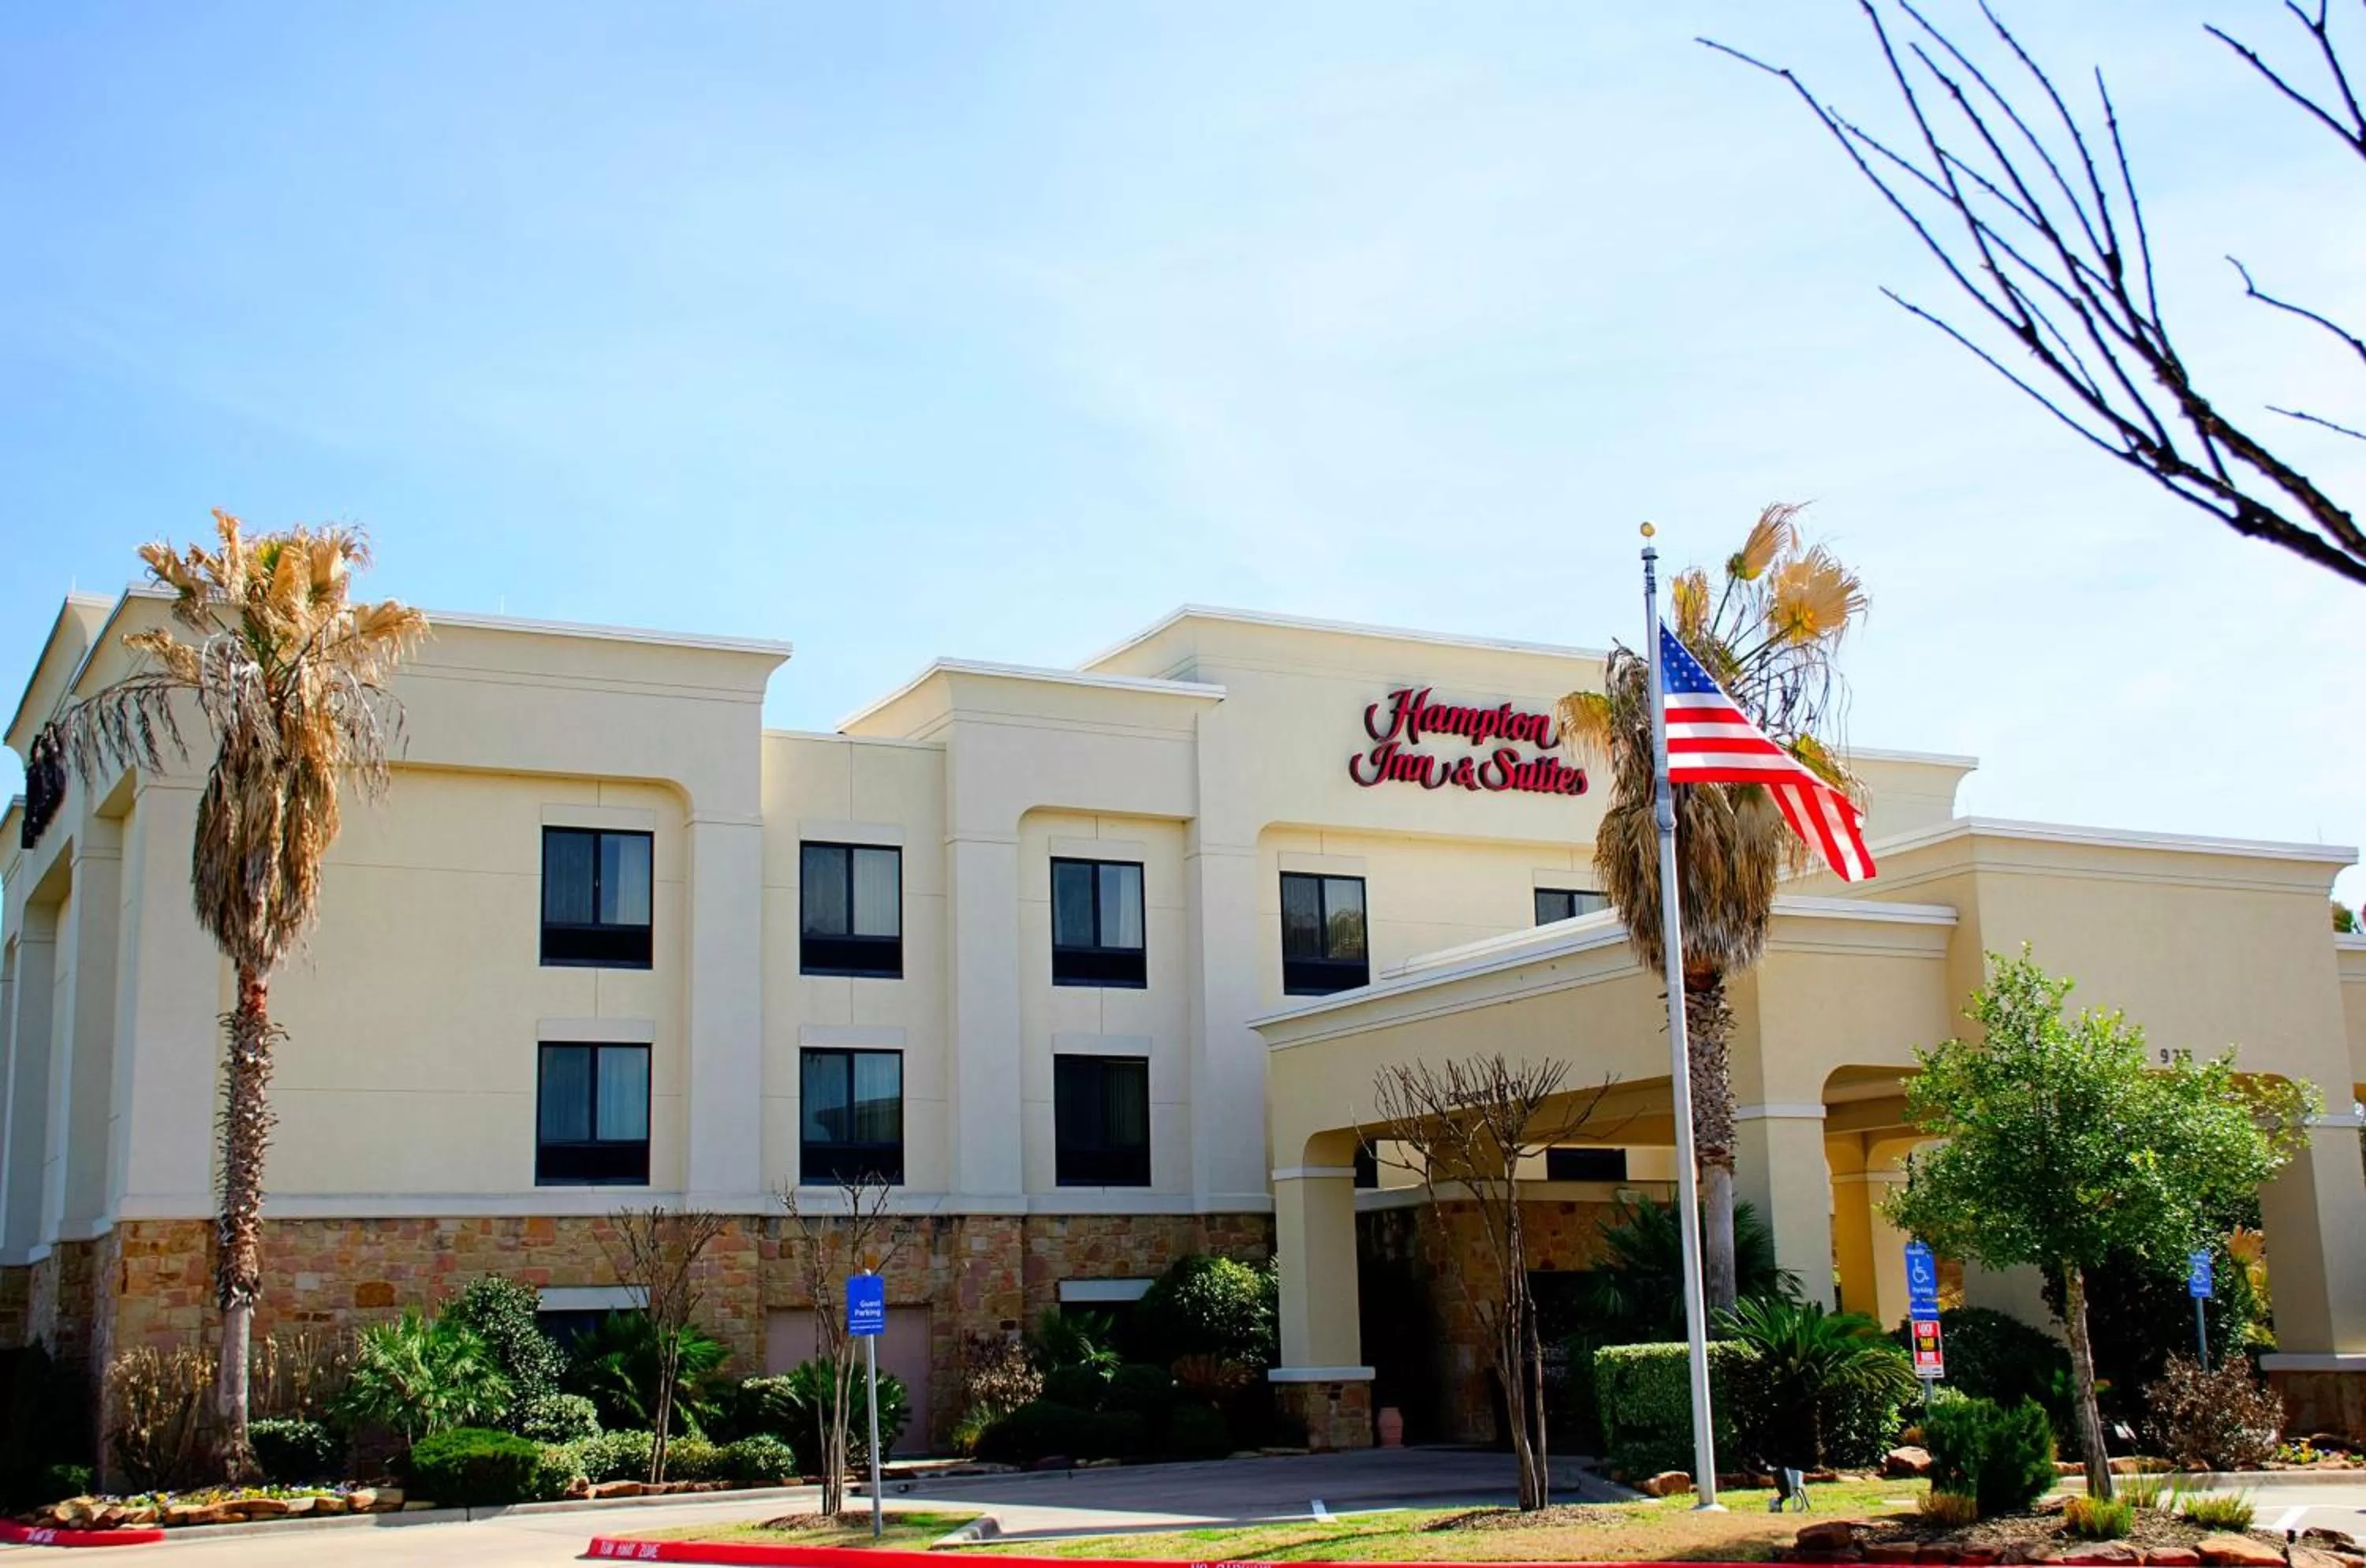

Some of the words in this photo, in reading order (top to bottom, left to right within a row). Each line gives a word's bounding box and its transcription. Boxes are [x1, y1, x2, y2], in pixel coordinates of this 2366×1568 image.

[1364, 686, 1560, 750] Hampton
[1349, 741, 1450, 790] Inn
[1450, 756, 1482, 791] &
[1478, 748, 1588, 795] Suites
[854, 1309, 881, 1317] Parking
